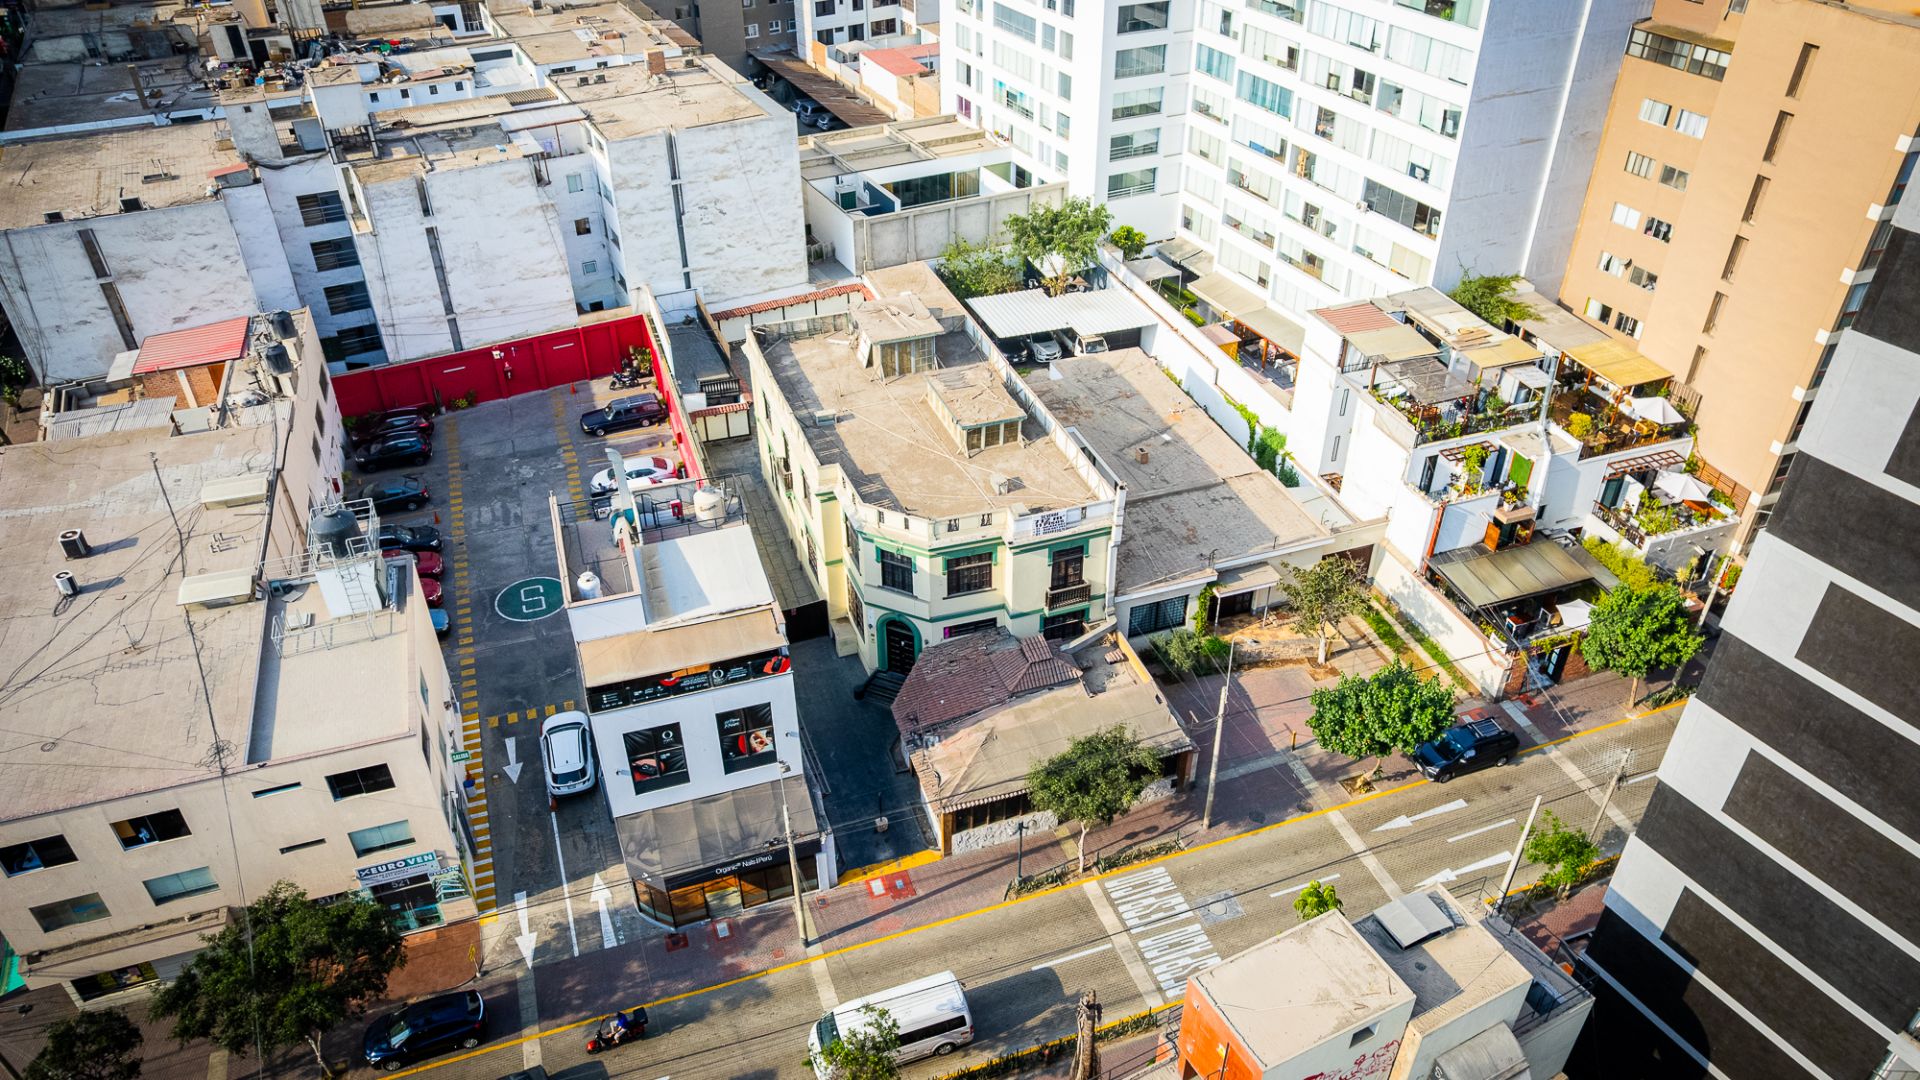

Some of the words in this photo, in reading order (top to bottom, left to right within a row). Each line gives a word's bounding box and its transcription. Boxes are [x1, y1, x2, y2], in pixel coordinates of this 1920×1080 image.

[520, 585, 546, 613] S
[391, 878, 411, 889] 521
[1104, 866, 1195, 934] DESPACIO
